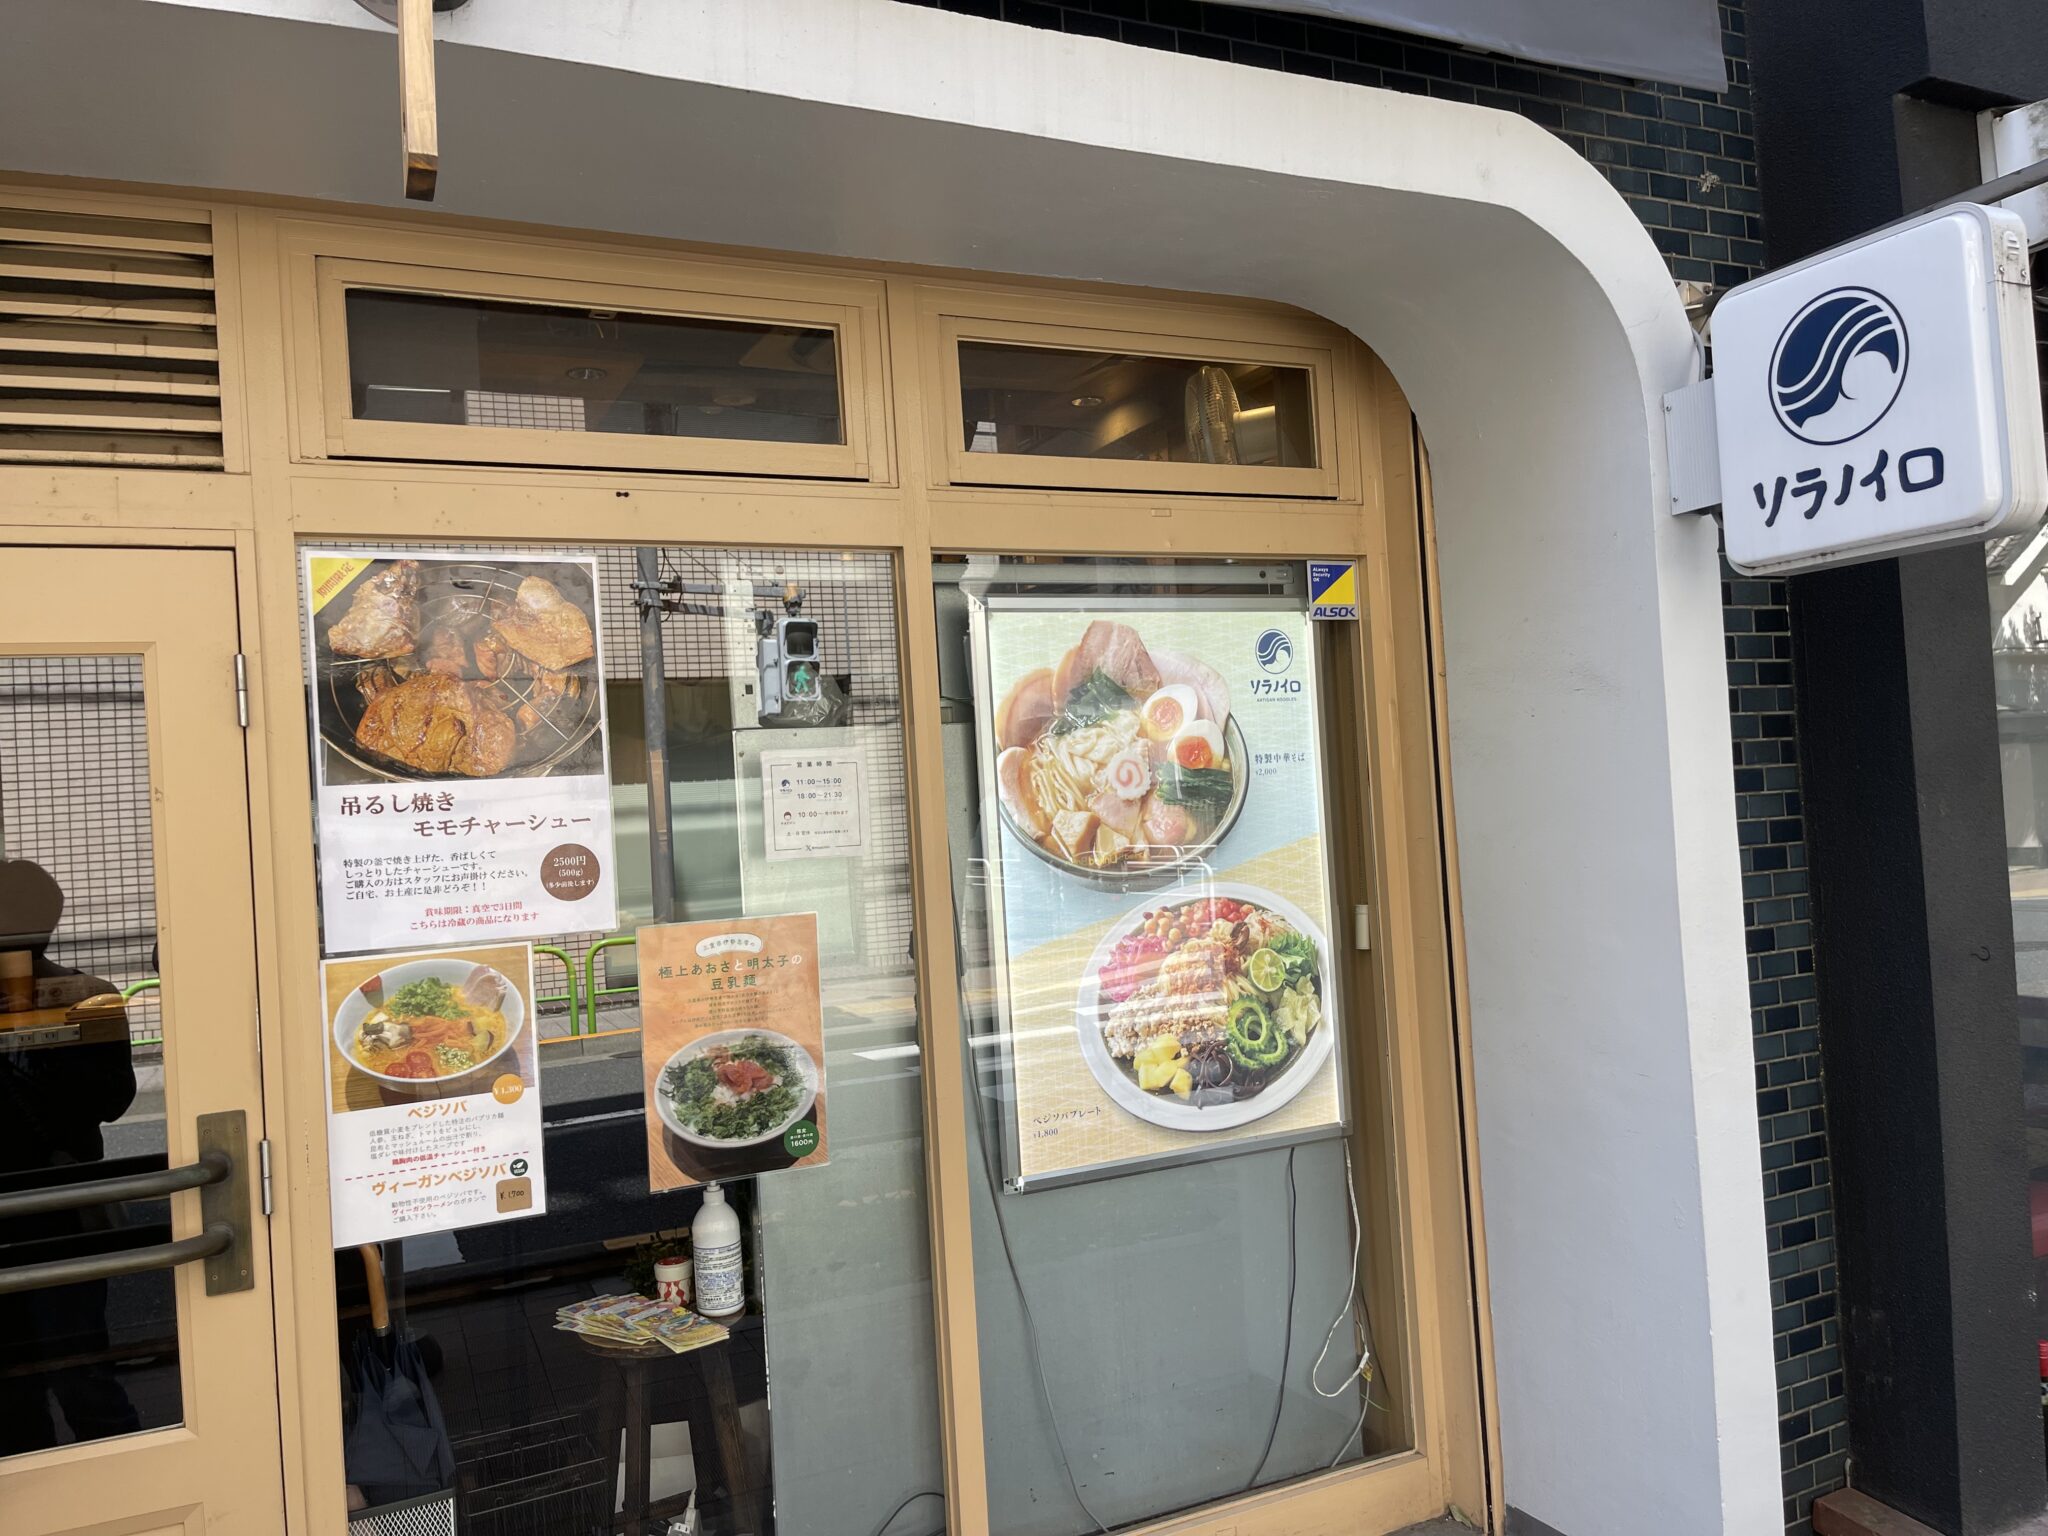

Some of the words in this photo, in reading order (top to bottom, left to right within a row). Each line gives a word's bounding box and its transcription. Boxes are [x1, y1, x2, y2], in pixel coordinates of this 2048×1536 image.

[1753, 446, 1944, 528] ソラノイロ
[1313, 606, 1356, 618] ALSOK
[1250, 678, 1301, 695] ソラノイロ
[1255, 752, 1305, 764] 特製中華そば
[341, 791, 455, 816] 吊るし焼き
[413, 814, 591, 837] モモチャーシュー
[345, 861, 482, 879] しっとりしたチャーシューです。
[553, 855, 586, 867] 2500円
[410, 911, 539, 930] こちらは冷蔵の商品になります
[658, 954, 802, 979] 極上あおさと明太子の
[711, 974, 757, 990] 豆乳麺
[408, 1100, 468, 1119] ベジソバ
[1033, 1106, 1101, 1124] ベジソバプレート
[371, 1162, 506, 1196] ヴィーガンベジソバ
